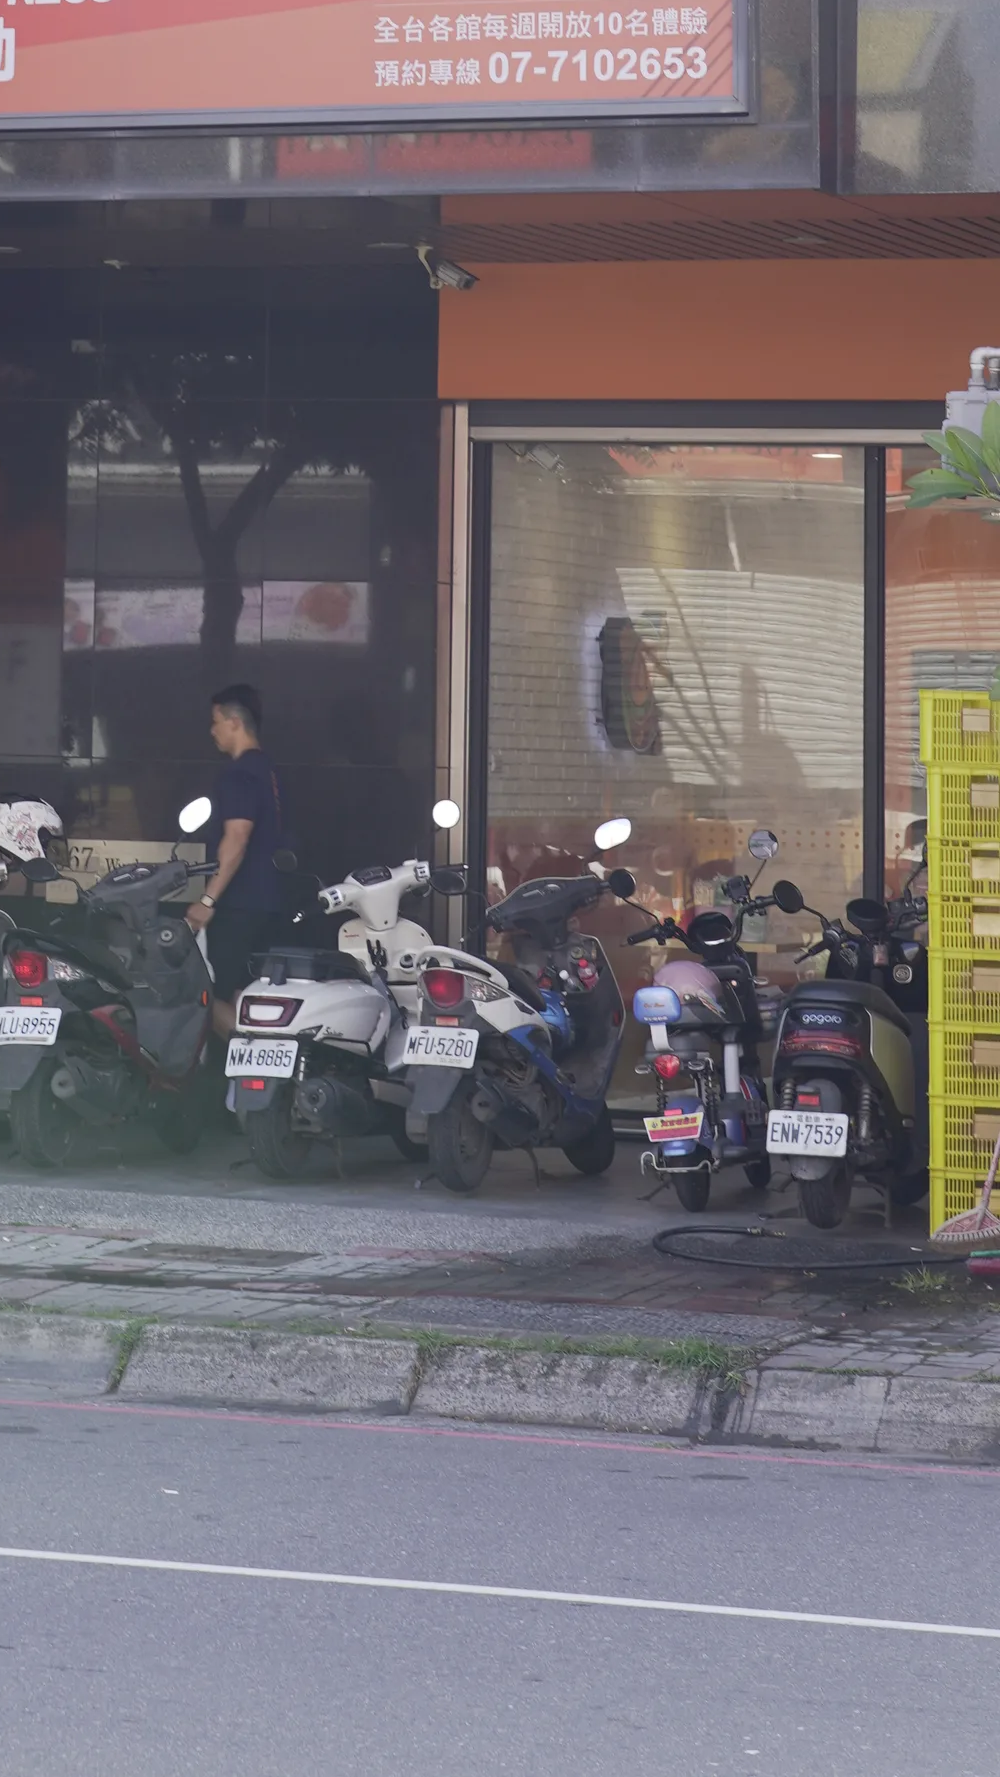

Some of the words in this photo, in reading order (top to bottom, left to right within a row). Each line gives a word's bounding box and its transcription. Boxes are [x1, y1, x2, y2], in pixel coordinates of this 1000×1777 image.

[373, 6, 709, 44] 全台各館每週開放10名體驗
[374, 58, 482, 88] 預約專線
[488, 46, 708, 84] 07-7102653
[802, 1013, 842, 1025] gogoro
